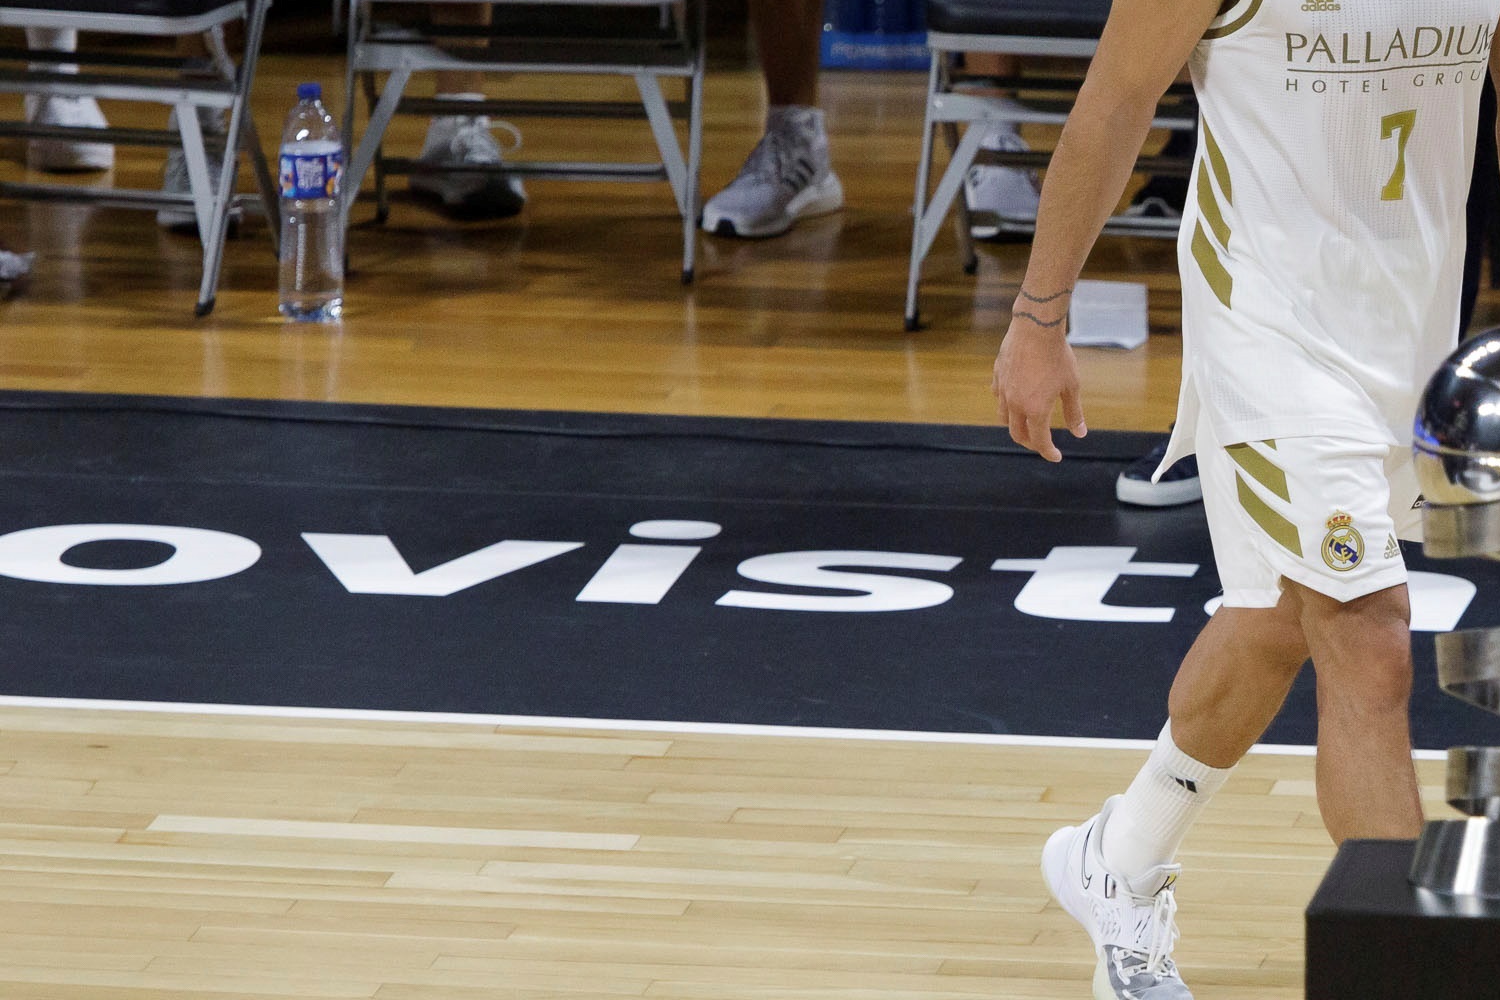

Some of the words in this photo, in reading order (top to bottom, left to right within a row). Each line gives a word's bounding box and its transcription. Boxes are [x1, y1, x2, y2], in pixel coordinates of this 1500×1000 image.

[1301, 1, 1341, 12] adidas
[1286, 78, 1389, 93] HOTEL
[1380, 109, 1418, 201] 7
